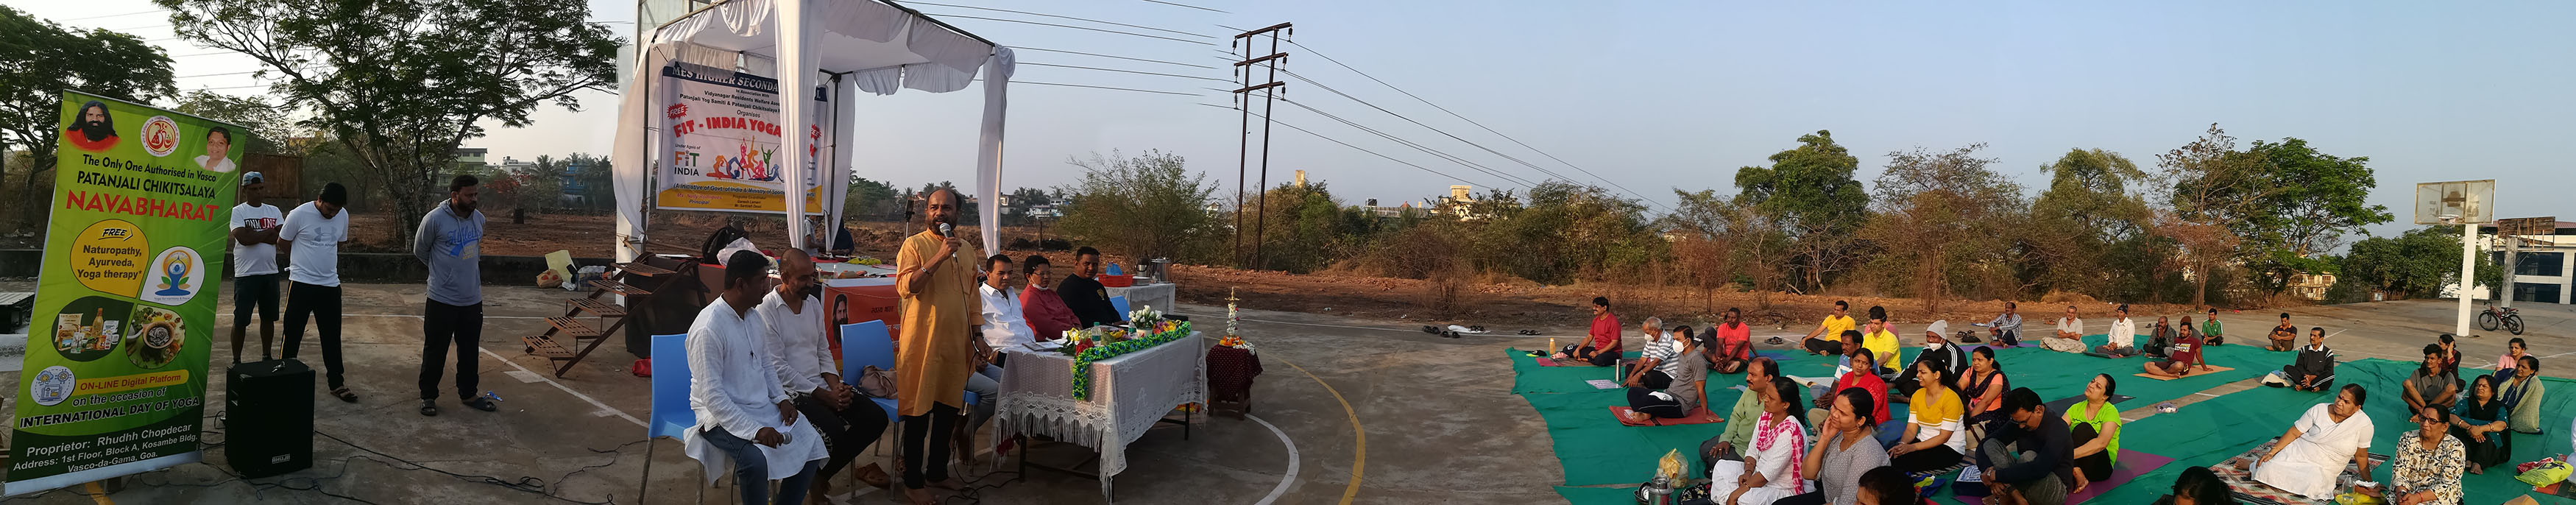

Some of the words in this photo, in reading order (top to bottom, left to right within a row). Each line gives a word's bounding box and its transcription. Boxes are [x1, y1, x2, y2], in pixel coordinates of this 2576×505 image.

[673, 67, 693, 78] MES
[679, 93, 701, 102] Patanjali
[704, 90, 731, 99] Vidyanagar
[732, 94, 753, 102] Residents
[669, 106, 684, 116] FREE
[737, 110, 760, 118] Organises
[673, 120, 695, 138] FIT
[706, 116, 747, 130] INDIA
[749, 119, 782, 138] YOGA
[82, 154, 99, 166] The
[102, 157, 123, 172] Only
[125, 160, 143, 172] One
[144, 164, 185, 177] Authorised
[188, 170, 194, 179] in
[197, 171, 216, 183] Vasco
[674, 166, 699, 177] INDIA
[77, 171, 141, 190] PATANJALI
[144, 180, 216, 199] CHIKITSALAYA
[66, 190, 219, 222] NAVABHARAT
[102, 228, 127, 237] FREE
[83, 245, 142, 257] Naturopathy,
[88, 258, 134, 268] Ayurveda,
[77, 269, 101, 280] Yoga
[80, 380, 118, 391] ON-LINE
[121, 378, 147, 388] Digital
[149, 374, 181, 384] Platform
[73, 398, 86, 407] on
[90, 395, 107, 405] the
[110, 389, 153, 403] occasion
[156, 386, 167, 397] of
[19, 406, 126, 428] INTERNATIONAL
[129, 403, 153, 415] DAY
[155, 400, 169, 411] OF
[172, 396, 200, 408] YOGA
[26, 441, 90, 457] Proprietor:
[97, 431, 138, 446] Rhudhh
[141, 424, 192, 439] Chopdecar
[13, 457, 58, 471] Address:
[61, 454, 76, 464] 1st
[78, 450, 103, 461] Floor,
[105, 446, 130, 456] Block
[131, 444, 140, 453] A,
[142, 438, 177, 450] Kosambe
[180, 434, 198, 443] Bldg.
[68, 455, 138, 473] Vasco-da-Gama,
[140, 451, 158, 460] Goa.
